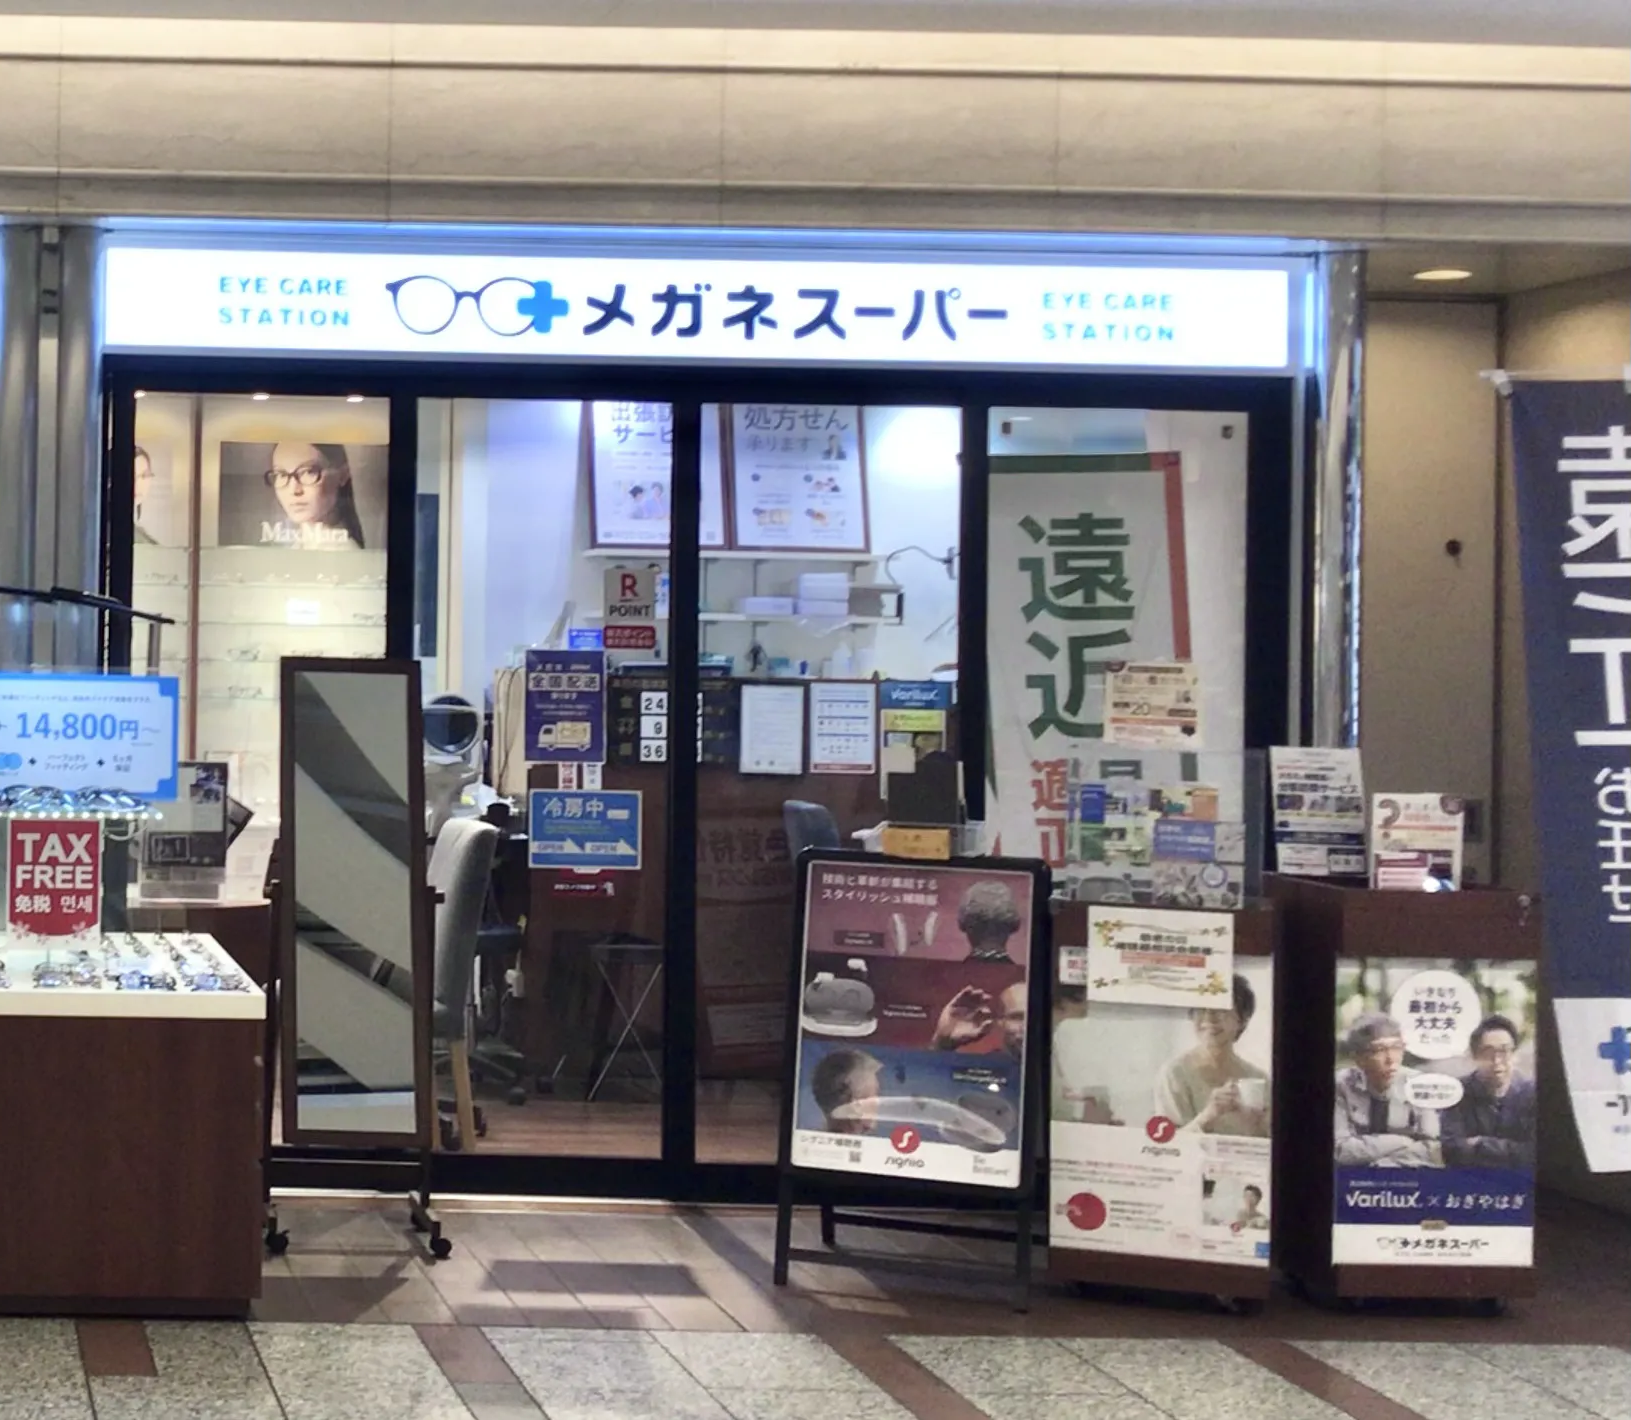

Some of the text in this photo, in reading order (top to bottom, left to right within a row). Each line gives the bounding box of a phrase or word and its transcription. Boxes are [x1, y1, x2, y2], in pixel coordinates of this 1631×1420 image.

[219, 275, 348, 297] EYE CARE
[582, 281, 1009, 342] メガネスーパー
[1042, 291, 1173, 313] EYE CARE
[218, 306, 351, 327] STATION
[1041, 323, 1175, 342] STATION
[743, 405, 849, 432] 処方せん
[746, 434, 812, 452] 承ります
[258, 521, 349, 543] MaxMara
[621, 573, 639, 598] R
[609, 604, 651, 618] POINT
[643, 697, 664, 711] 24
[642, 745, 664, 758] 36
[542, 797, 605, 819] 冷房中
[16, 832, 92, 864] TAX
[15, 866, 95, 889] FREE
[14, 894, 51, 914] 免税
[1414, 1016, 1458, 1031] 大丈夫
[884, 1155, 926, 1169] signia
[1346, 1190, 1421, 1209] Varilux
[1445, 1193, 1526, 1210] おぎやはぎ
[1413, 1238, 1490, 1250] メガネスーパー
